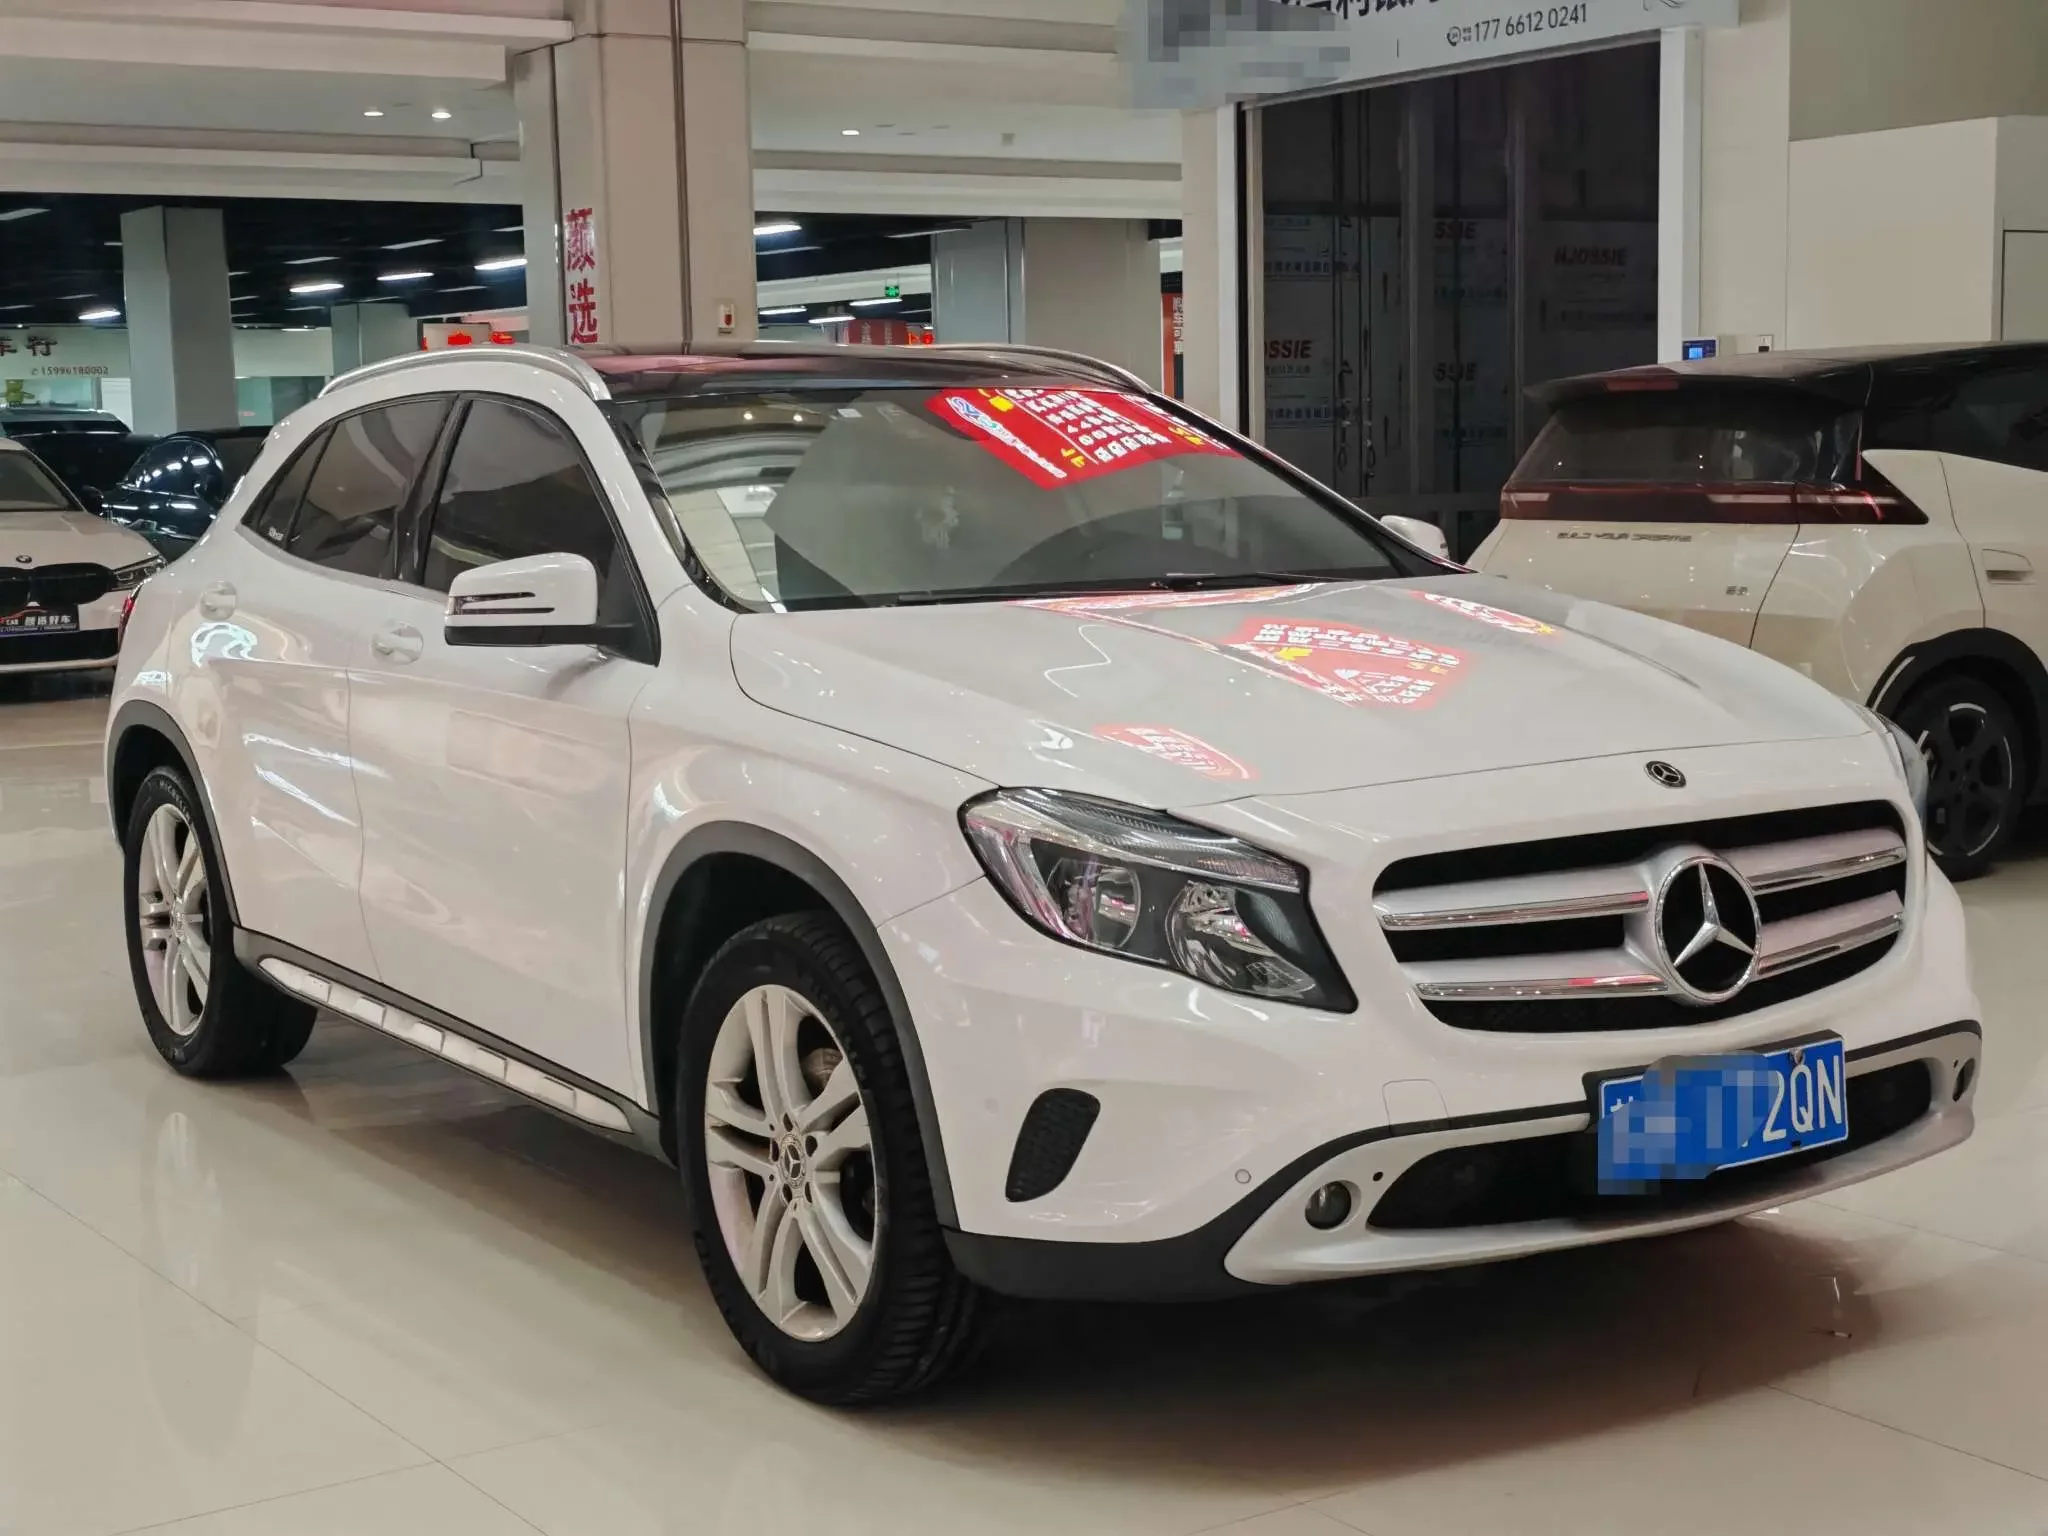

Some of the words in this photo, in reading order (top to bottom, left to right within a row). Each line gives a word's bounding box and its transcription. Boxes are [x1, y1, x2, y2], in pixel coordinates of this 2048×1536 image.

[1474, 18, 1500, 42] 177
[1505, 10, 1543, 36] 6612
[1548, 3, 1587, 29] 0241
[1265, 339, 1313, 359] SSIE
